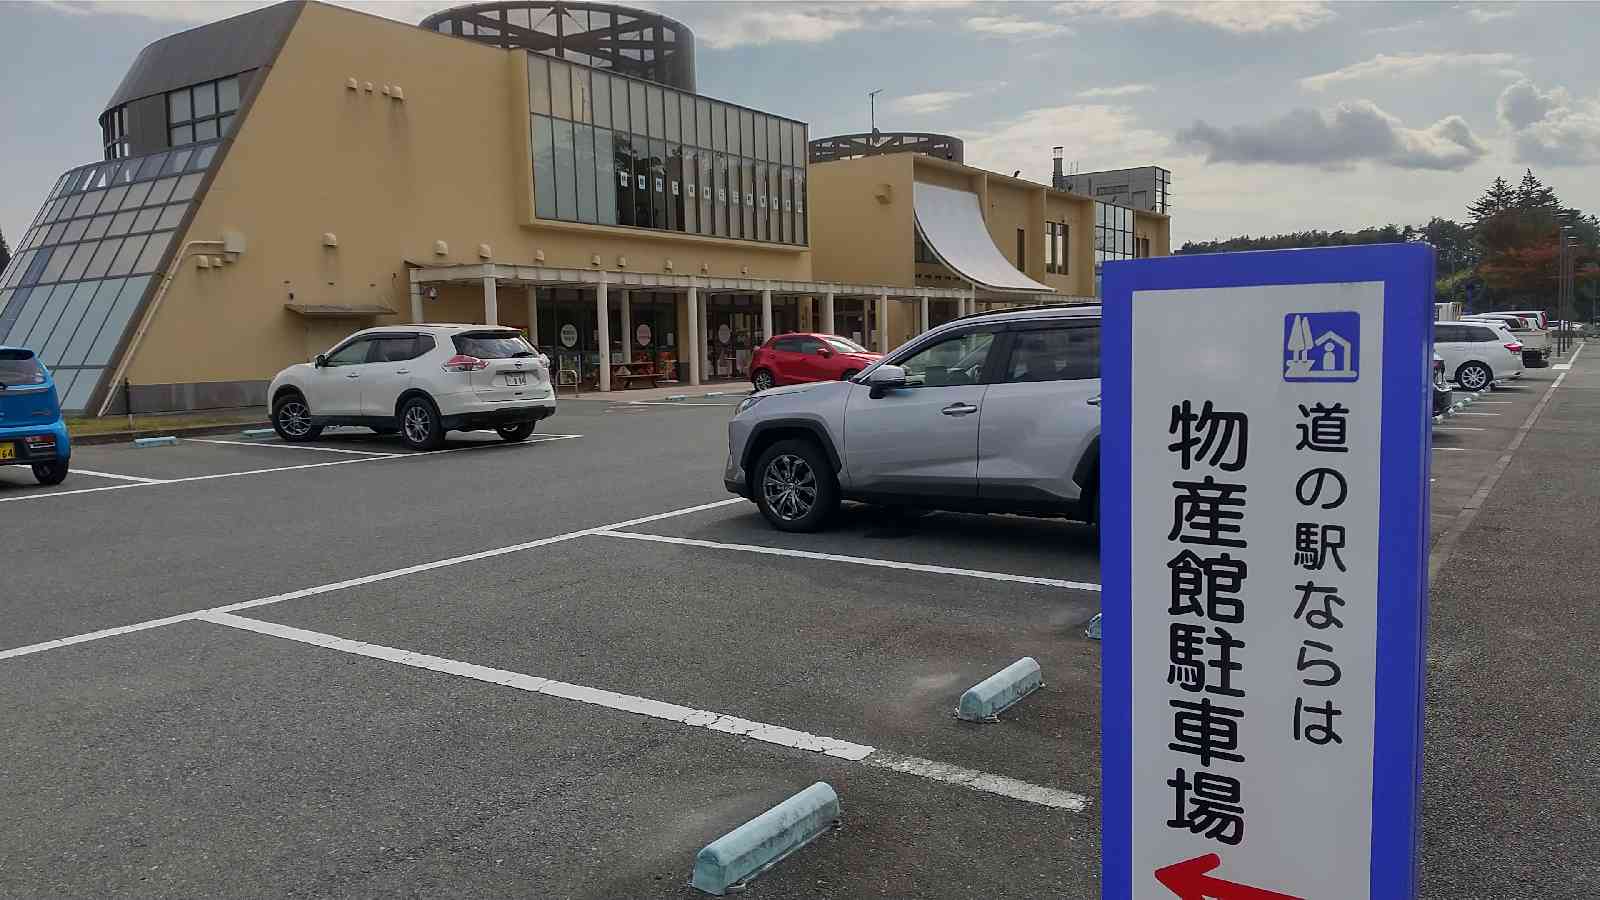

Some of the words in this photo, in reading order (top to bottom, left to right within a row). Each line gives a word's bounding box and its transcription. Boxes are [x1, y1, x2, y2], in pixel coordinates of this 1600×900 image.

[1167, 399, 1249, 846] 物産館駐車場
[1293, 401, 1350, 746] 道の駅ならは
